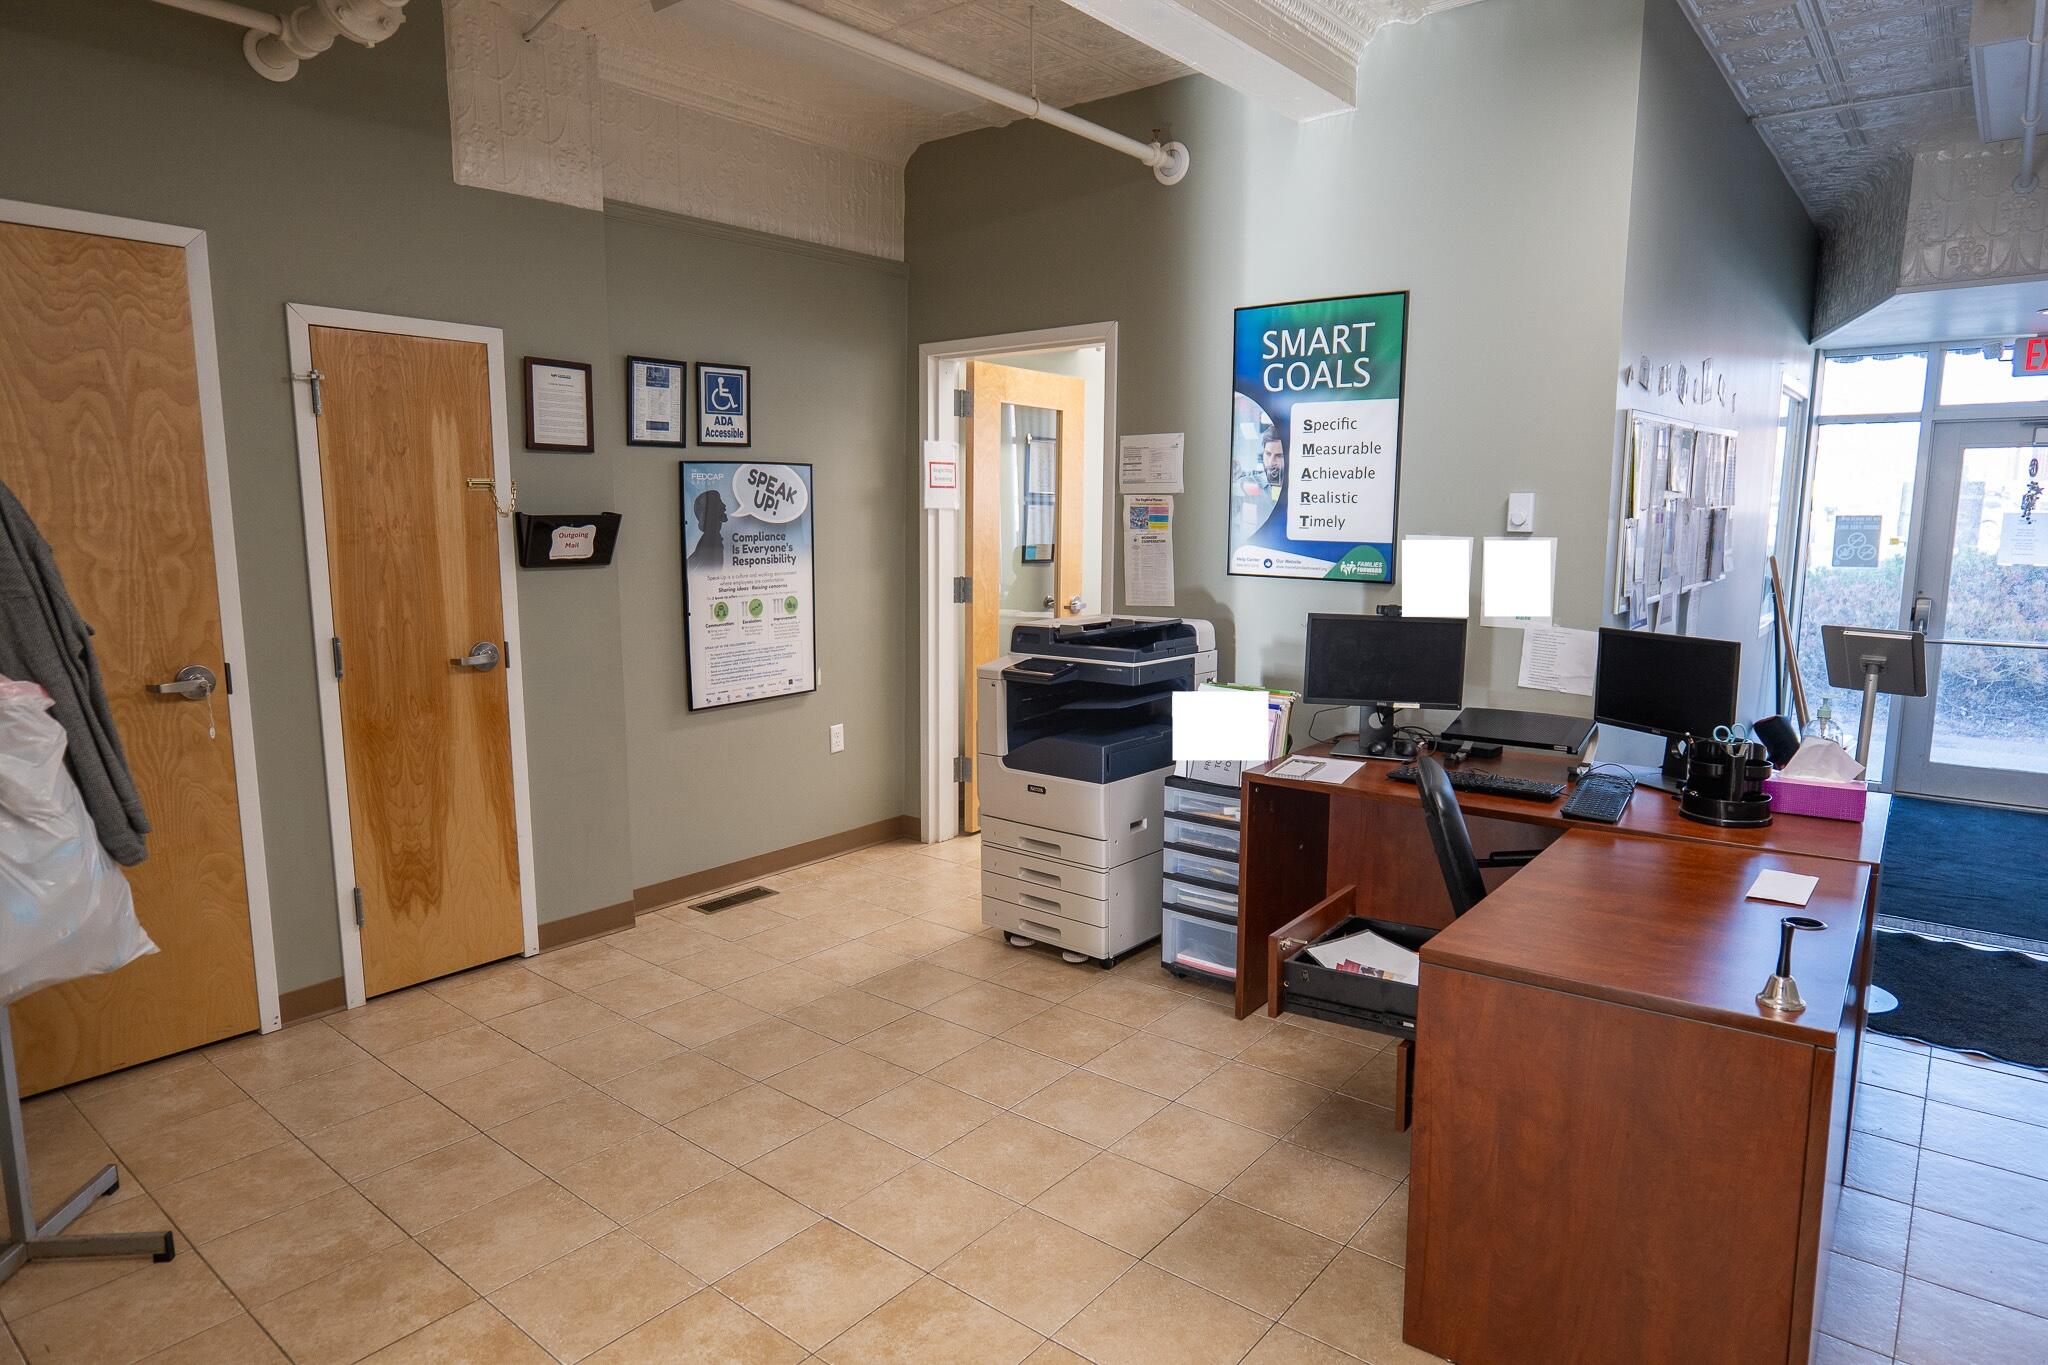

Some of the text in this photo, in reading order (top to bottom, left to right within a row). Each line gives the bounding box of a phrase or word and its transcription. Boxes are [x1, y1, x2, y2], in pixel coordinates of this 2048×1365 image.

[1262, 322, 1376, 360] SMART
[1263, 357, 1371, 392] GOALS
[714, 416, 733, 426] ADA
[1303, 417, 1357, 433] Specific
[705, 427, 744, 438] Accessible
[1302, 441, 1382, 455] Measurable
[1301, 466, 1376, 479] Achievable
[747, 468, 798, 504] SPEAK
[753, 489, 779, 516] UP!
[1300, 491, 1358, 504] Realistic
[1299, 515, 1345, 530] Timely
[732, 531, 786, 544] Compliance
[732, 543, 793, 555] Is Everyone's
[732, 553, 797, 567] Responsibility
